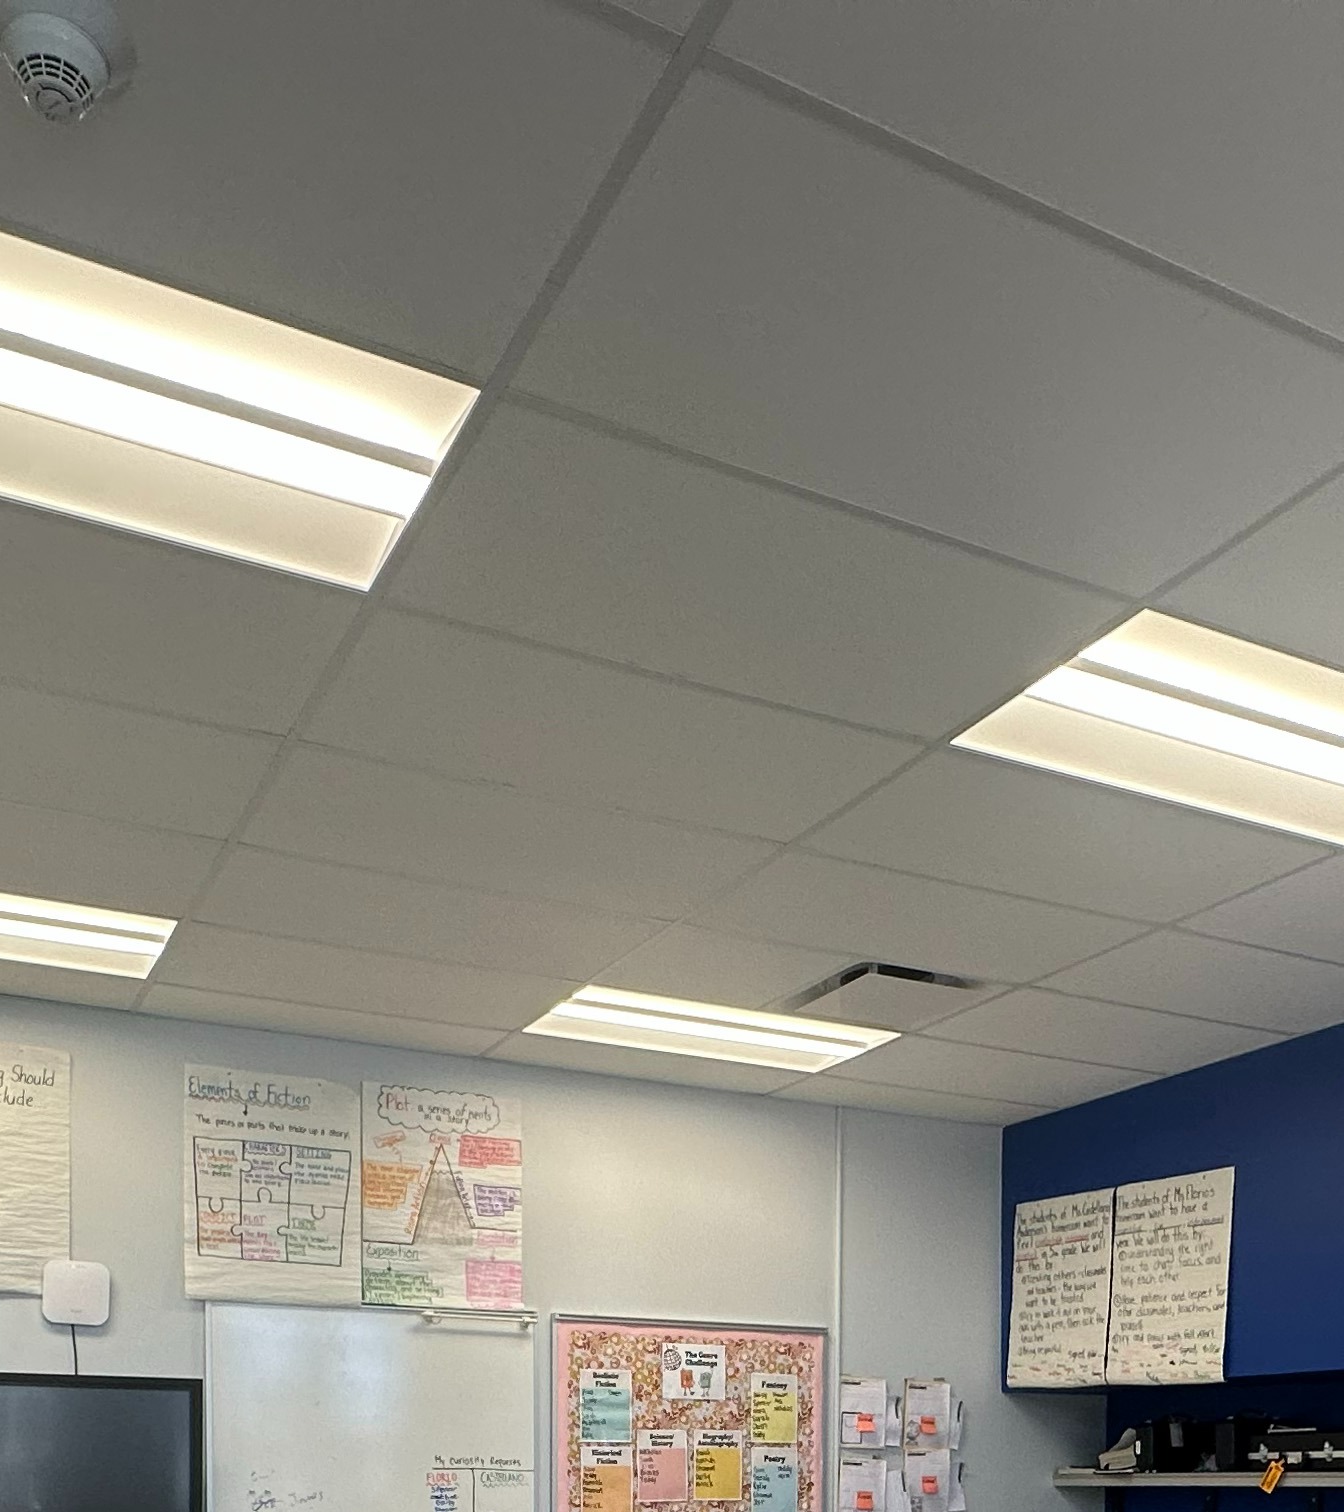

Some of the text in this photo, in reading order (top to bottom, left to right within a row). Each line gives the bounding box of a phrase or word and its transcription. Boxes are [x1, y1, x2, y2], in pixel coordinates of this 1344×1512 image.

[12, 1063, 55, 1088] Should
[188, 1076, 311, 1105] Elements of Fiction
[455, 1103, 467, 1118] of
[685, 1351, 697, 1359] The
[763, 1454, 787, 1465] Poetry
[425, 1472, 458, 1483] FLORIO
